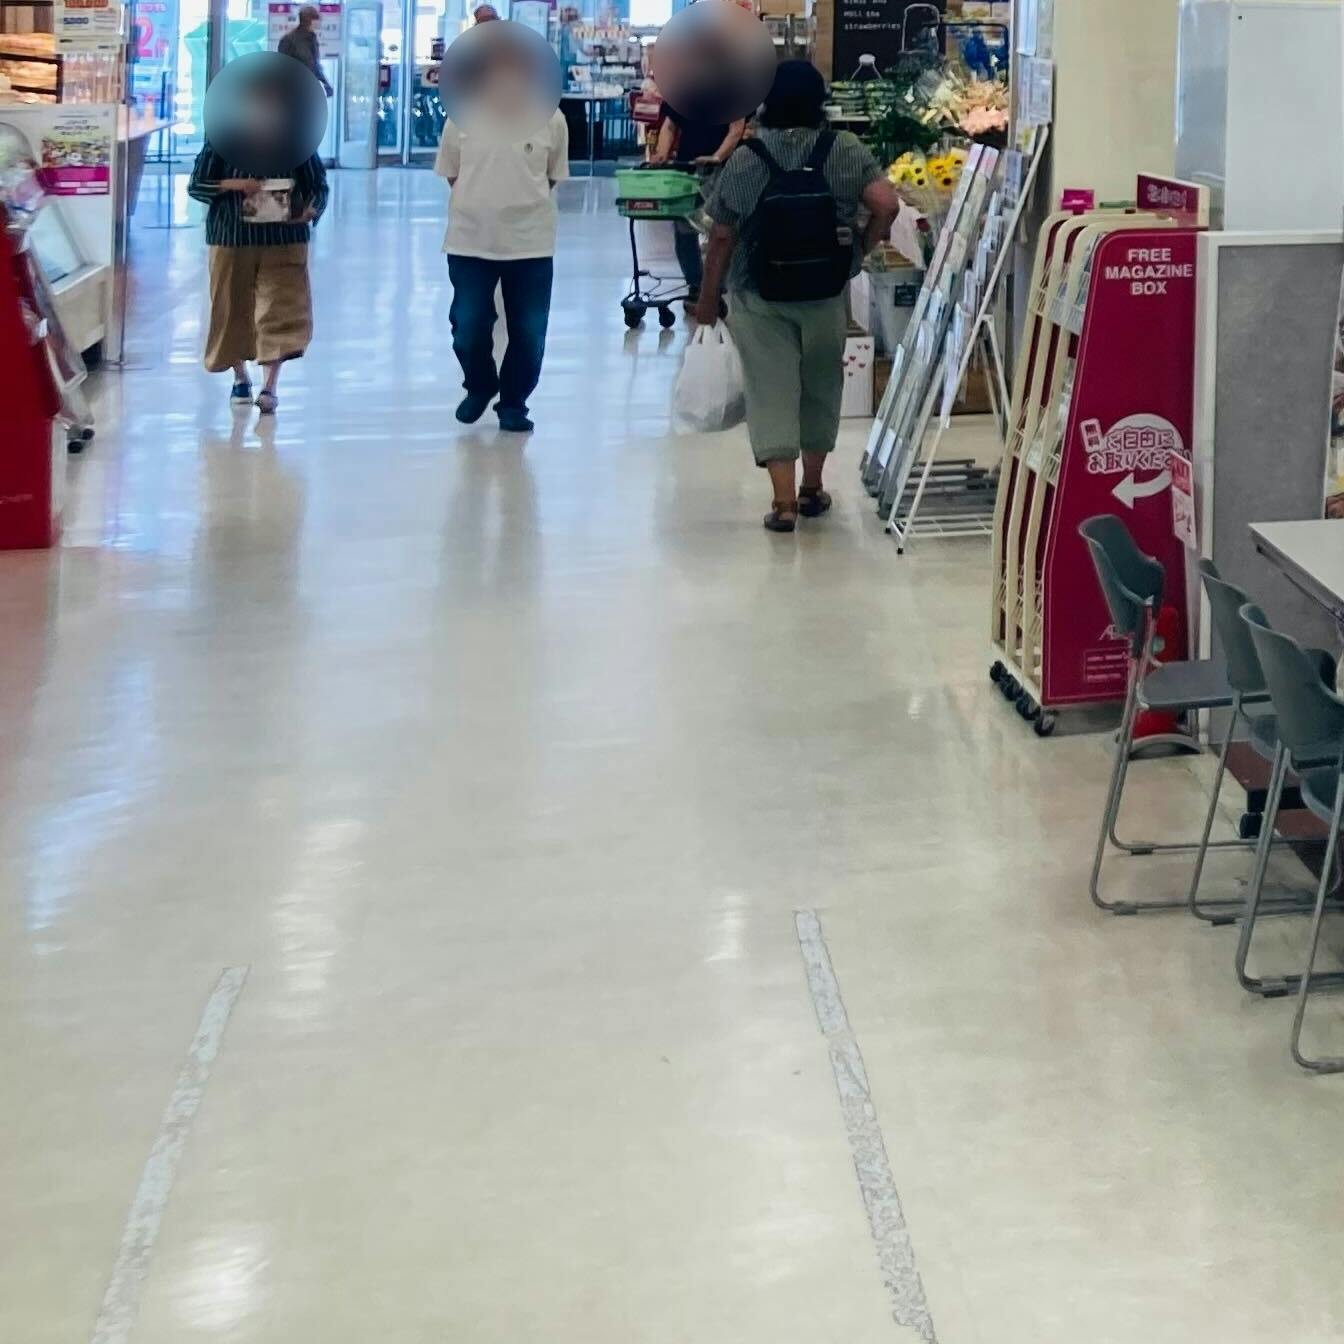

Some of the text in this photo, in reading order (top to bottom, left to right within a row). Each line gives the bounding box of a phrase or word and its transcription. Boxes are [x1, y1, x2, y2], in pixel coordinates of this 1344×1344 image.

[1127, 248, 1172, 263] FREE
[1104, 263, 1194, 280] MAGAZINE
[1131, 282, 1168, 295] BOX
